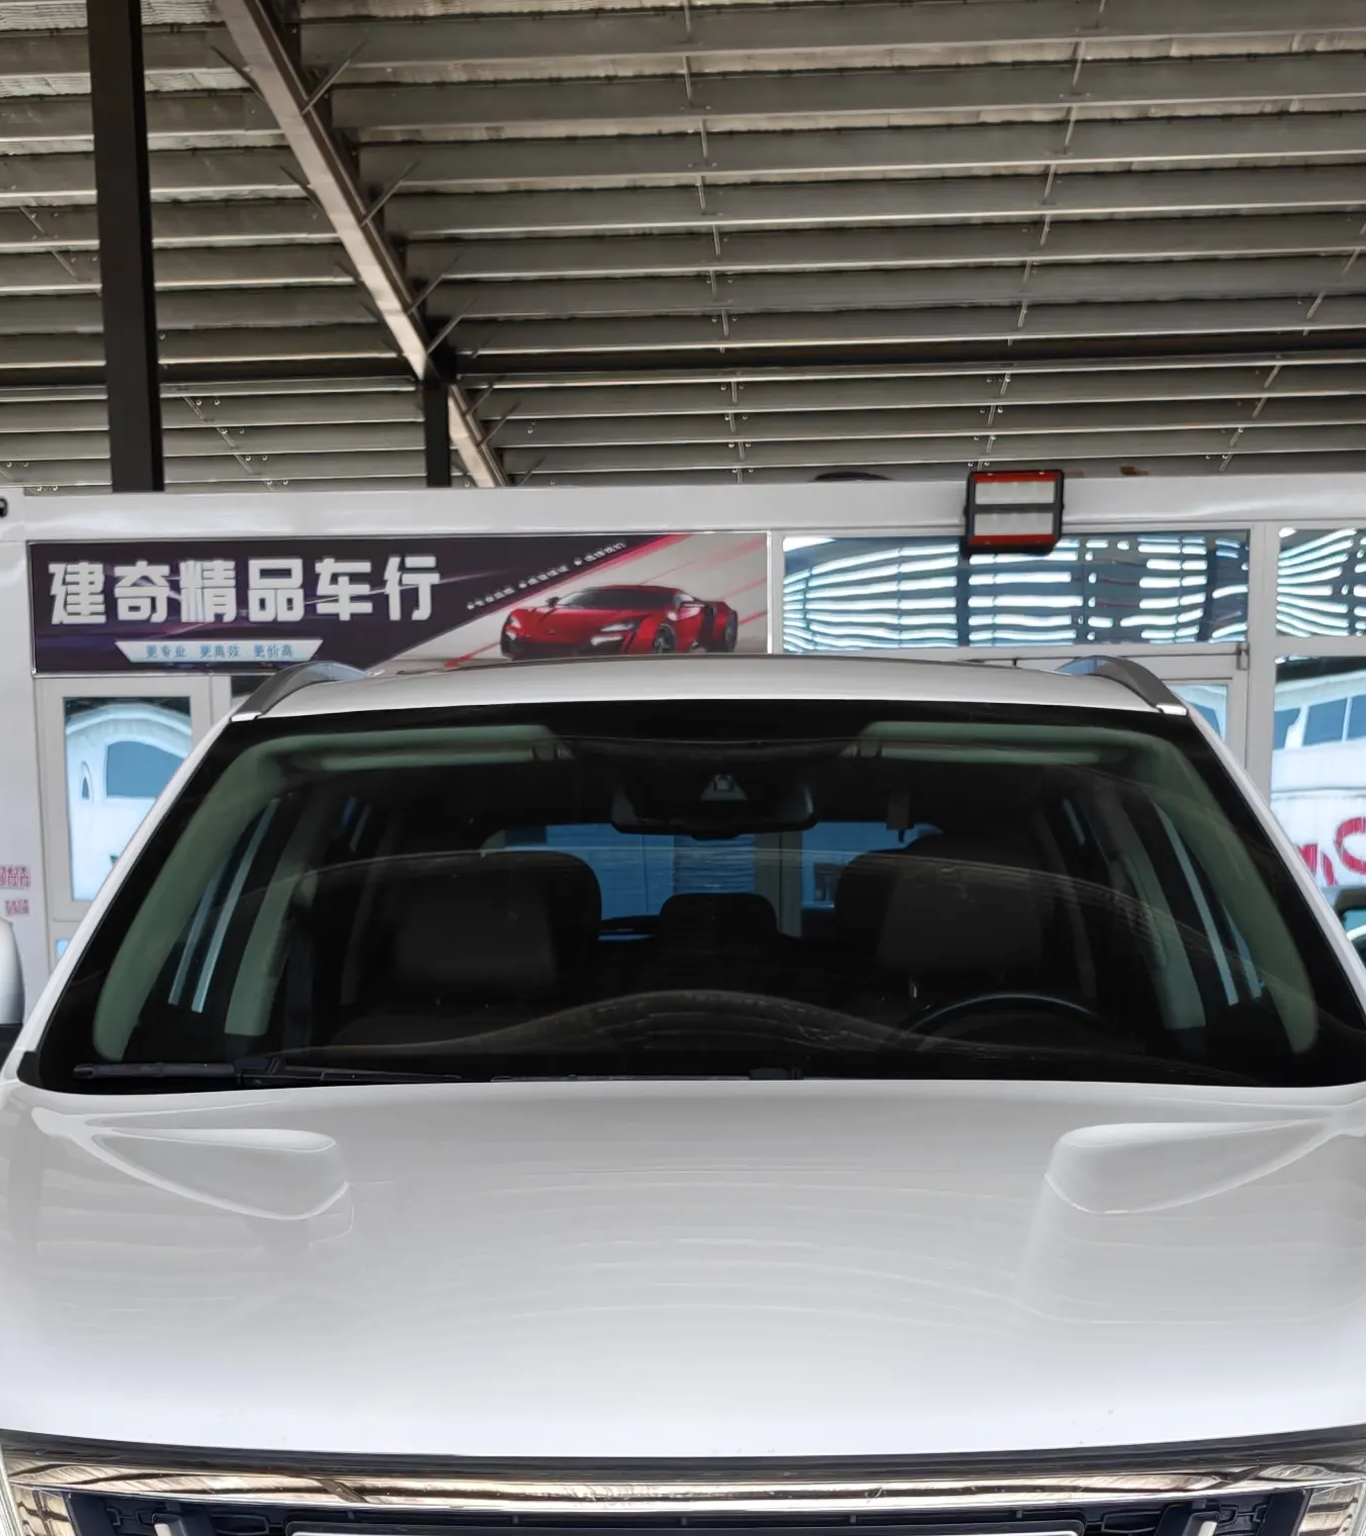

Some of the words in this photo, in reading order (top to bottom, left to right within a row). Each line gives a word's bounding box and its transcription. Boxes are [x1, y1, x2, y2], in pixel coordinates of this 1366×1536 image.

[49, 555, 440, 625] 建奇精品车行
